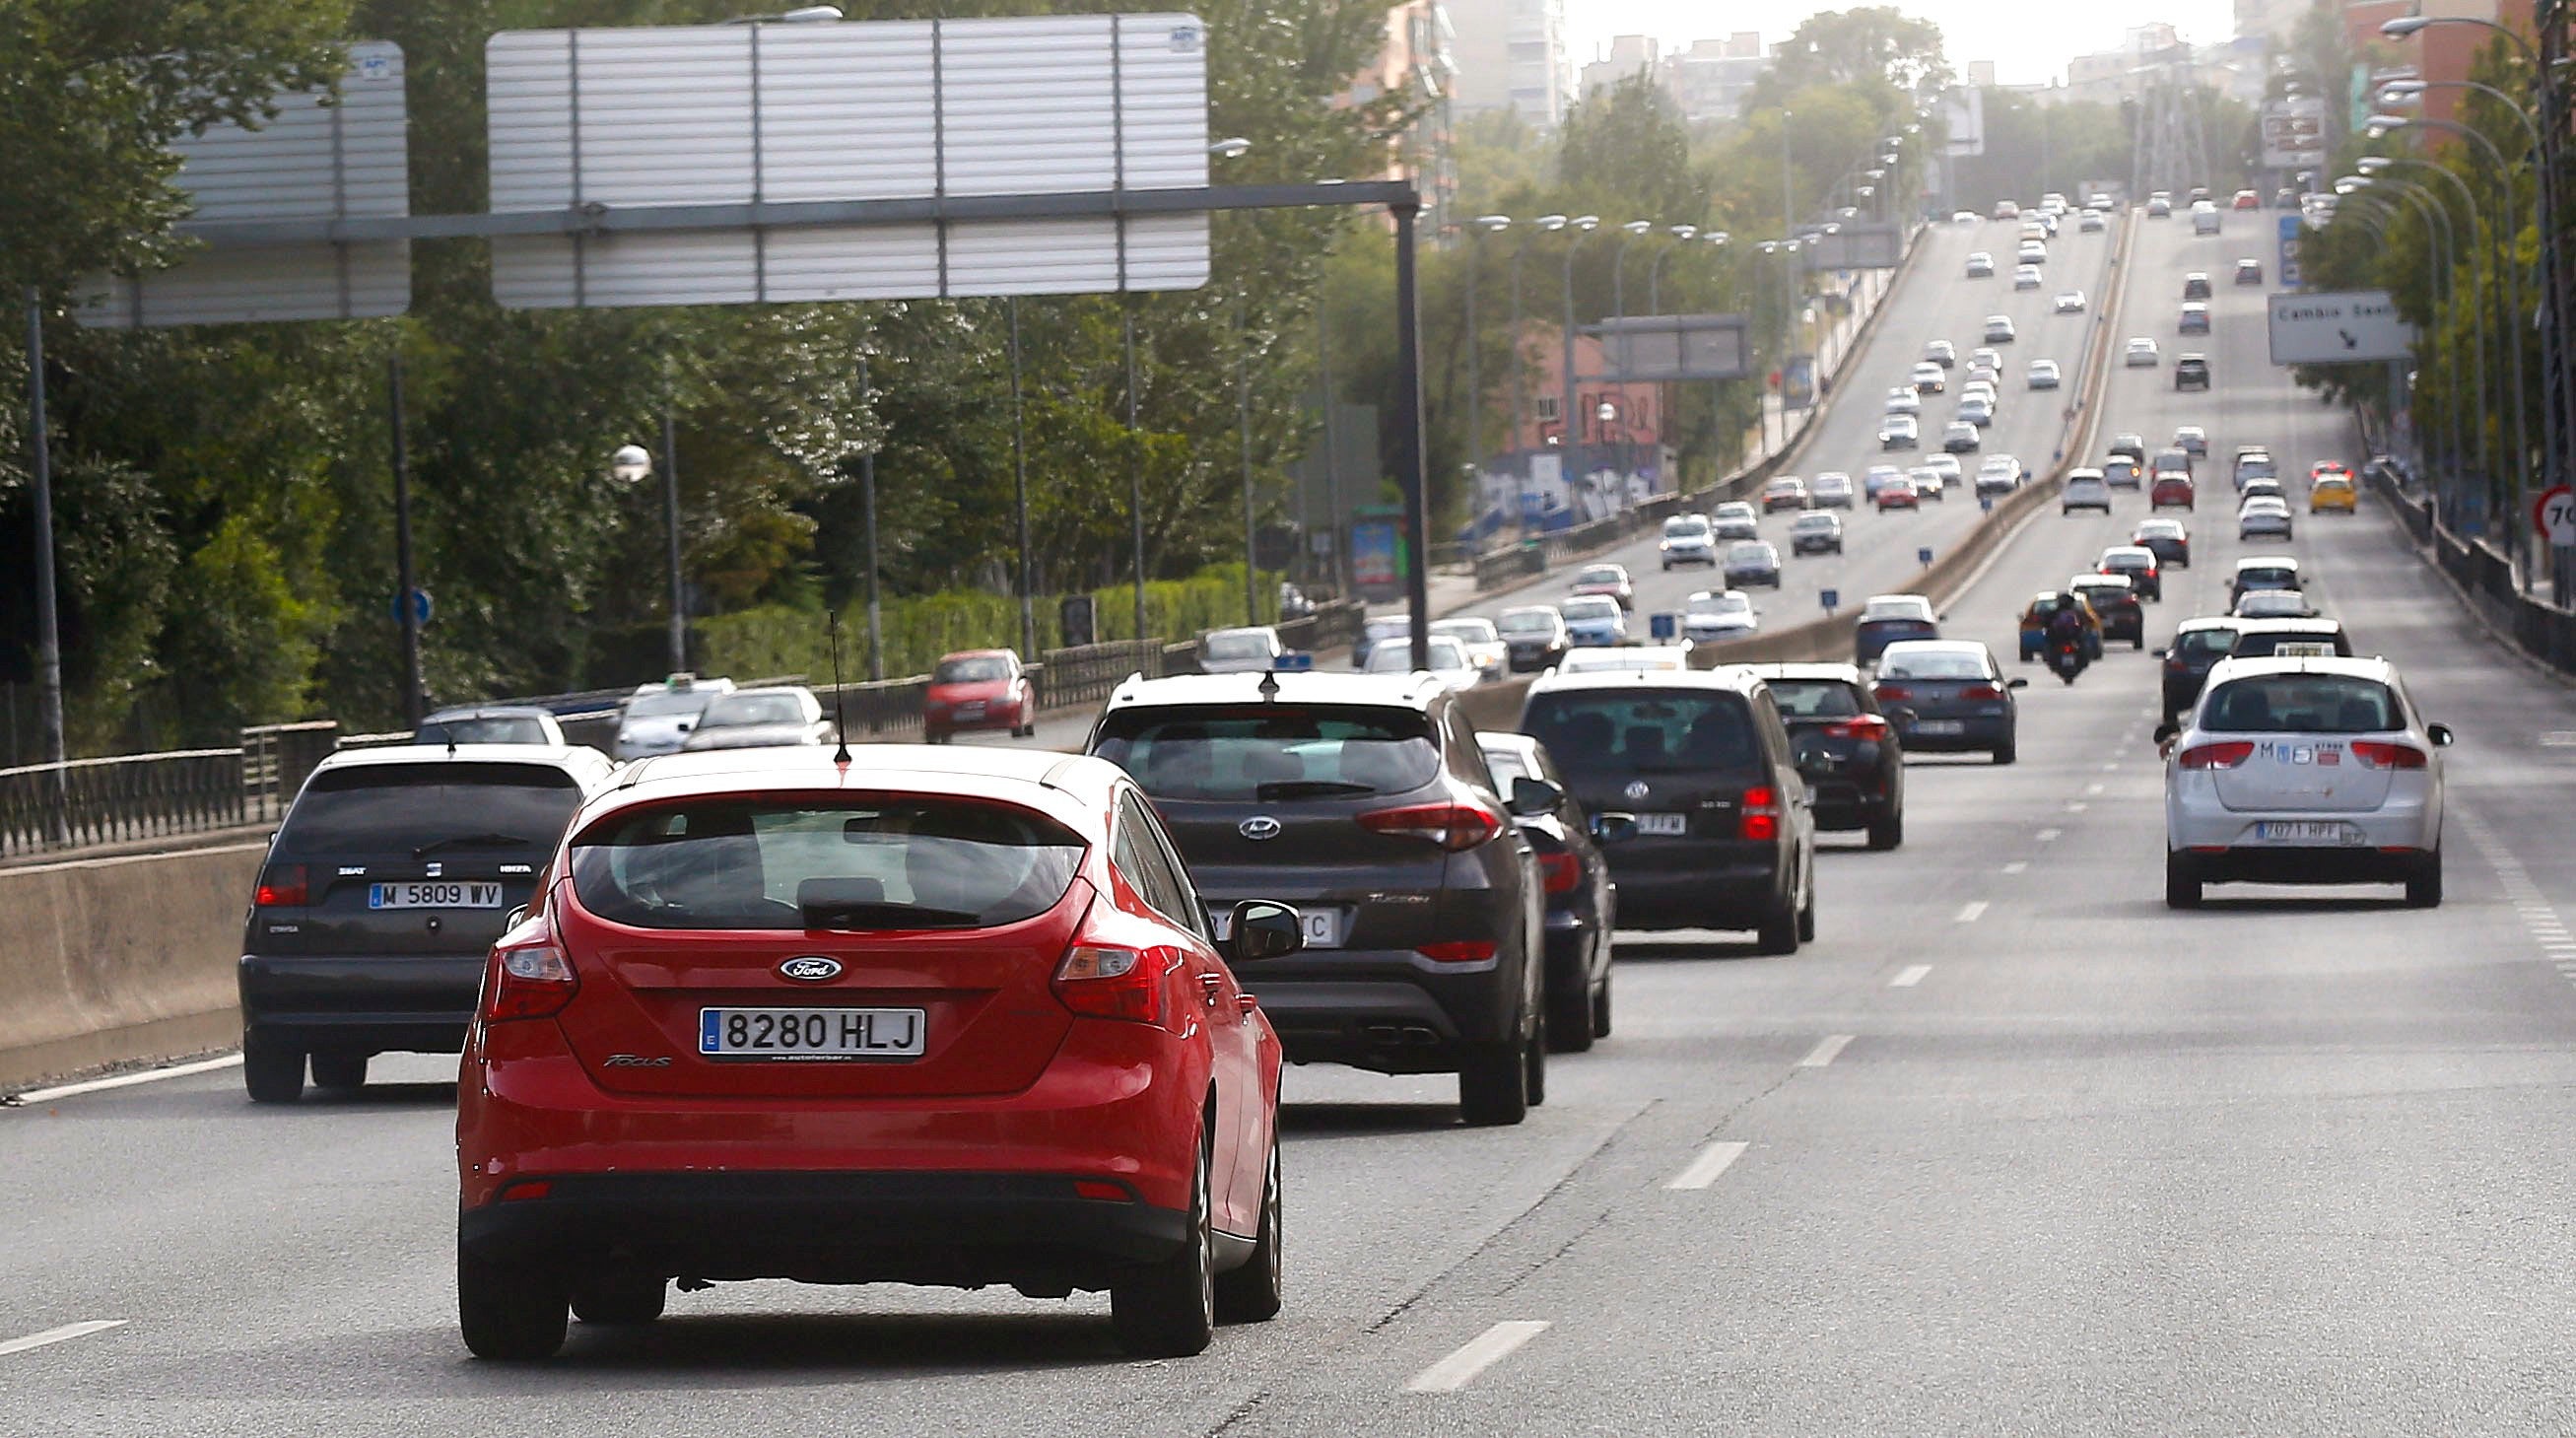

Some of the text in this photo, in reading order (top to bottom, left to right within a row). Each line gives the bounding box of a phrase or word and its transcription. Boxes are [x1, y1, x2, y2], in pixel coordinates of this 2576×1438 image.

[2278, 305, 2341, 321] Cambio
[2261, 741, 2272, 758] M
[338, 866, 367, 875] SEAT
[383, 885, 497, 904] M 5809 WV
[792, 959, 830, 976] Ford
[706, 1013, 915, 1049] E 8280 HLJ
